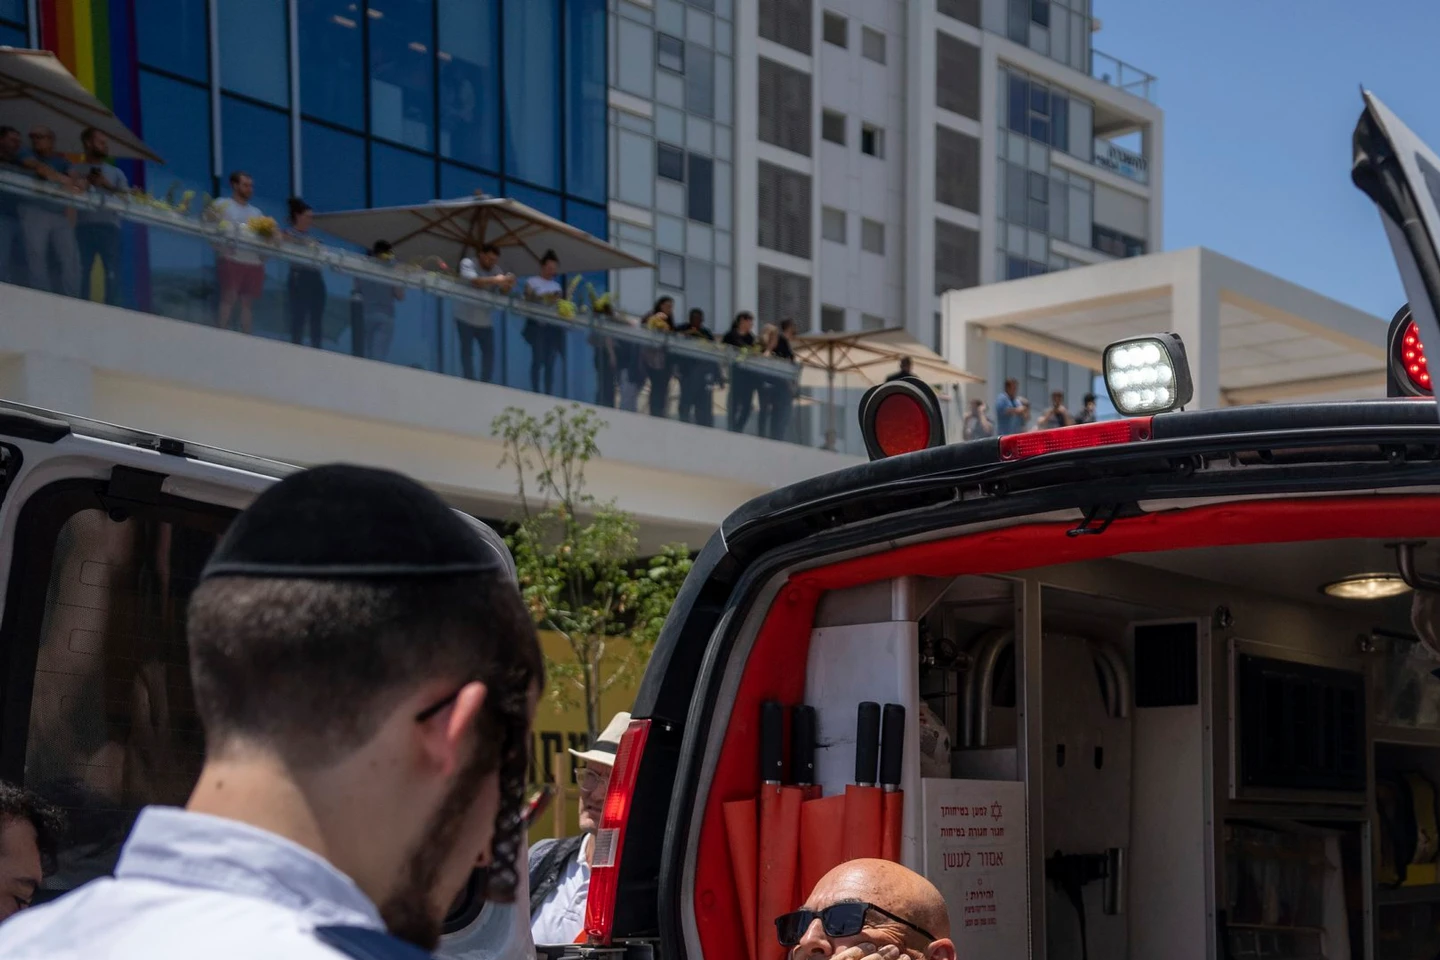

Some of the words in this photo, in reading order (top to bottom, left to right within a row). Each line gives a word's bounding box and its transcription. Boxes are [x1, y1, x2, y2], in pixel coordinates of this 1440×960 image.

[940, 805, 969, 818] בטיחותך
[972, 805, 988, 818] למען
[940, 827, 966, 837] בטיחות
[968, 827, 988, 837] חגורת
[990, 826, 1005, 837] חגור
[942, 850, 972, 871] לעשן
[976, 851, 1004, 867] אסור
